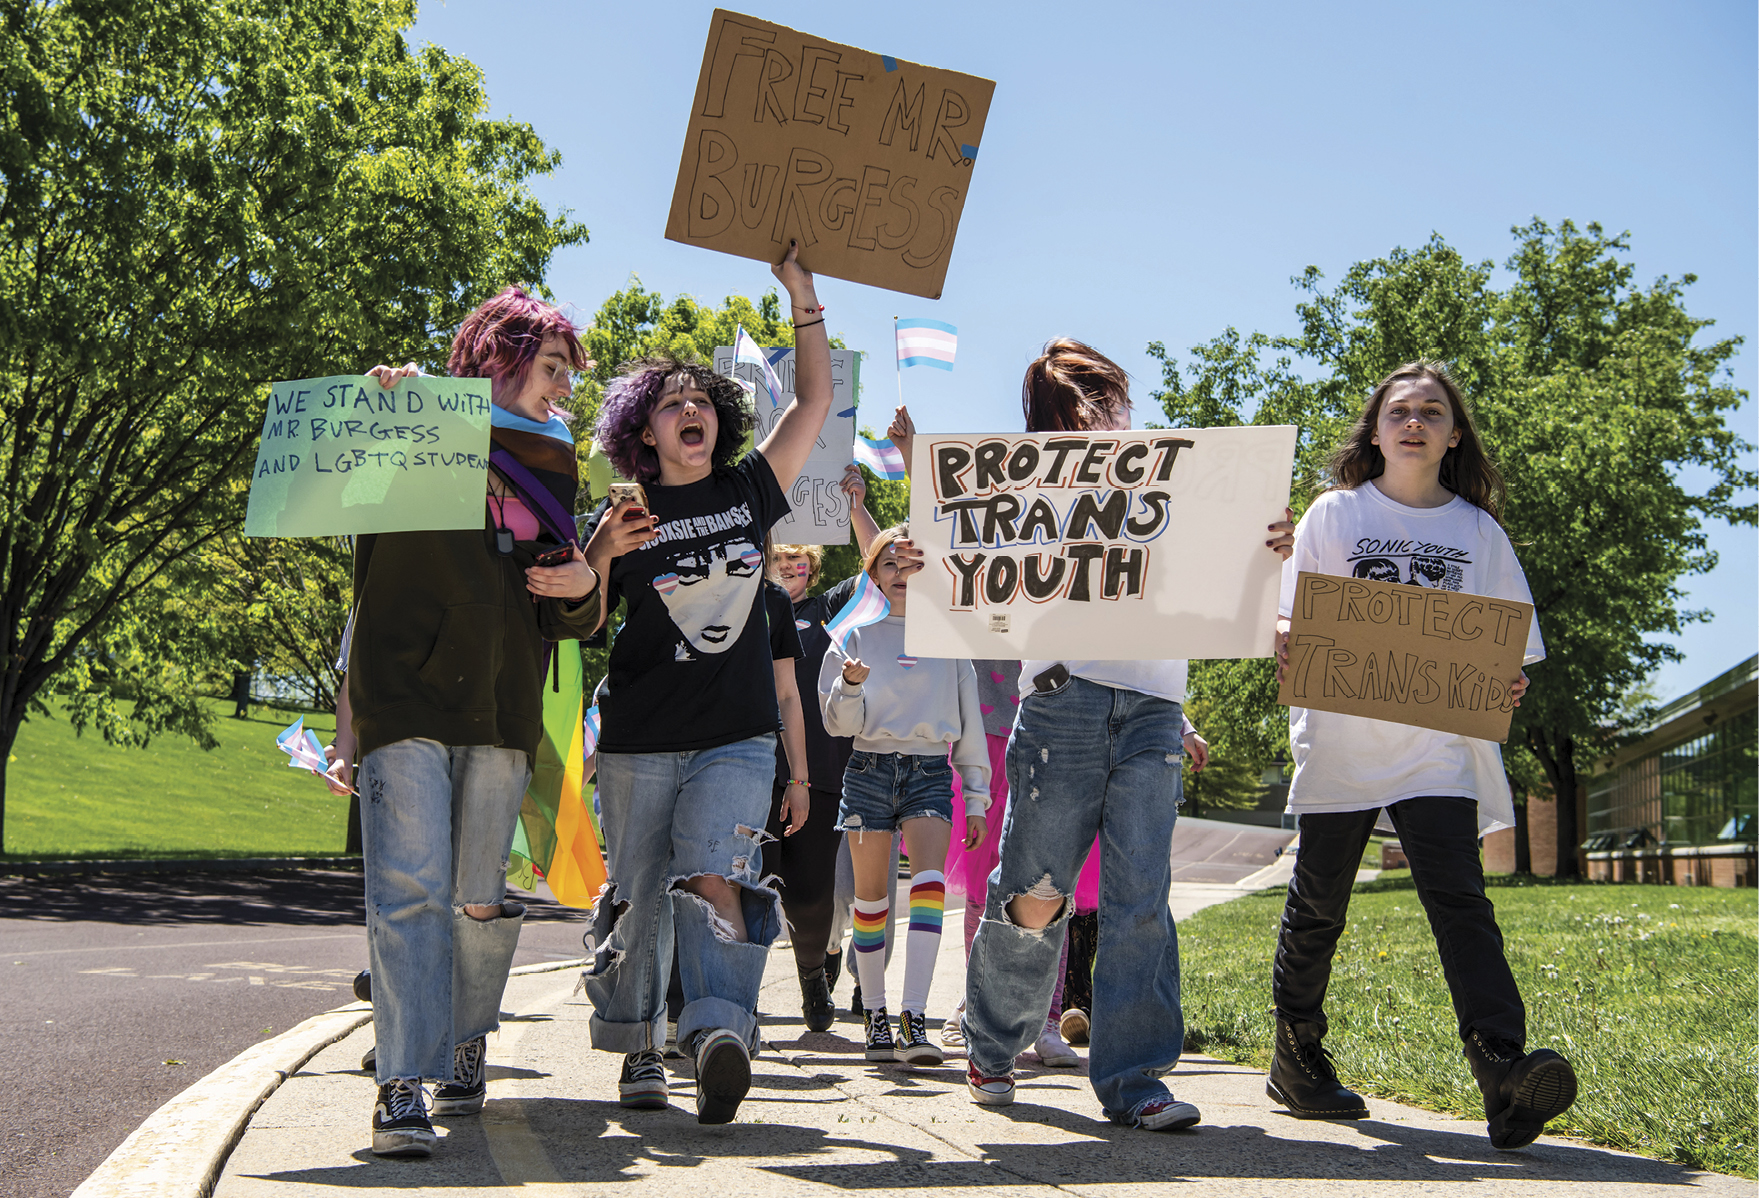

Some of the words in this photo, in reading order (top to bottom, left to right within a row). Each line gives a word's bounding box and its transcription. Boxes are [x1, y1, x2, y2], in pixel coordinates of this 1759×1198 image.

[701, 19, 864, 136] FREE
[879, 76, 972, 167] MR.
[688, 129, 959, 268] BURGESS
[274, 390, 311, 415] WE
[323, 384, 424, 414] STAND
[310, 418, 440, 444] BURGESS
[258, 454, 300, 478] AND
[315, 449, 408, 473] LGBTQ
[933, 437, 1195, 501] PROTECT
[696, 526, 710, 537] THE
[936, 490, 1171, 548] TRANS
[1352, 538, 1414, 555] SONIC
[1413, 541, 1469, 558] YOUTH
[945, 543, 1149, 609] YOUTH
[1303, 577, 1522, 646] PROTECT
[1293, 634, 1440, 704] TRANS
